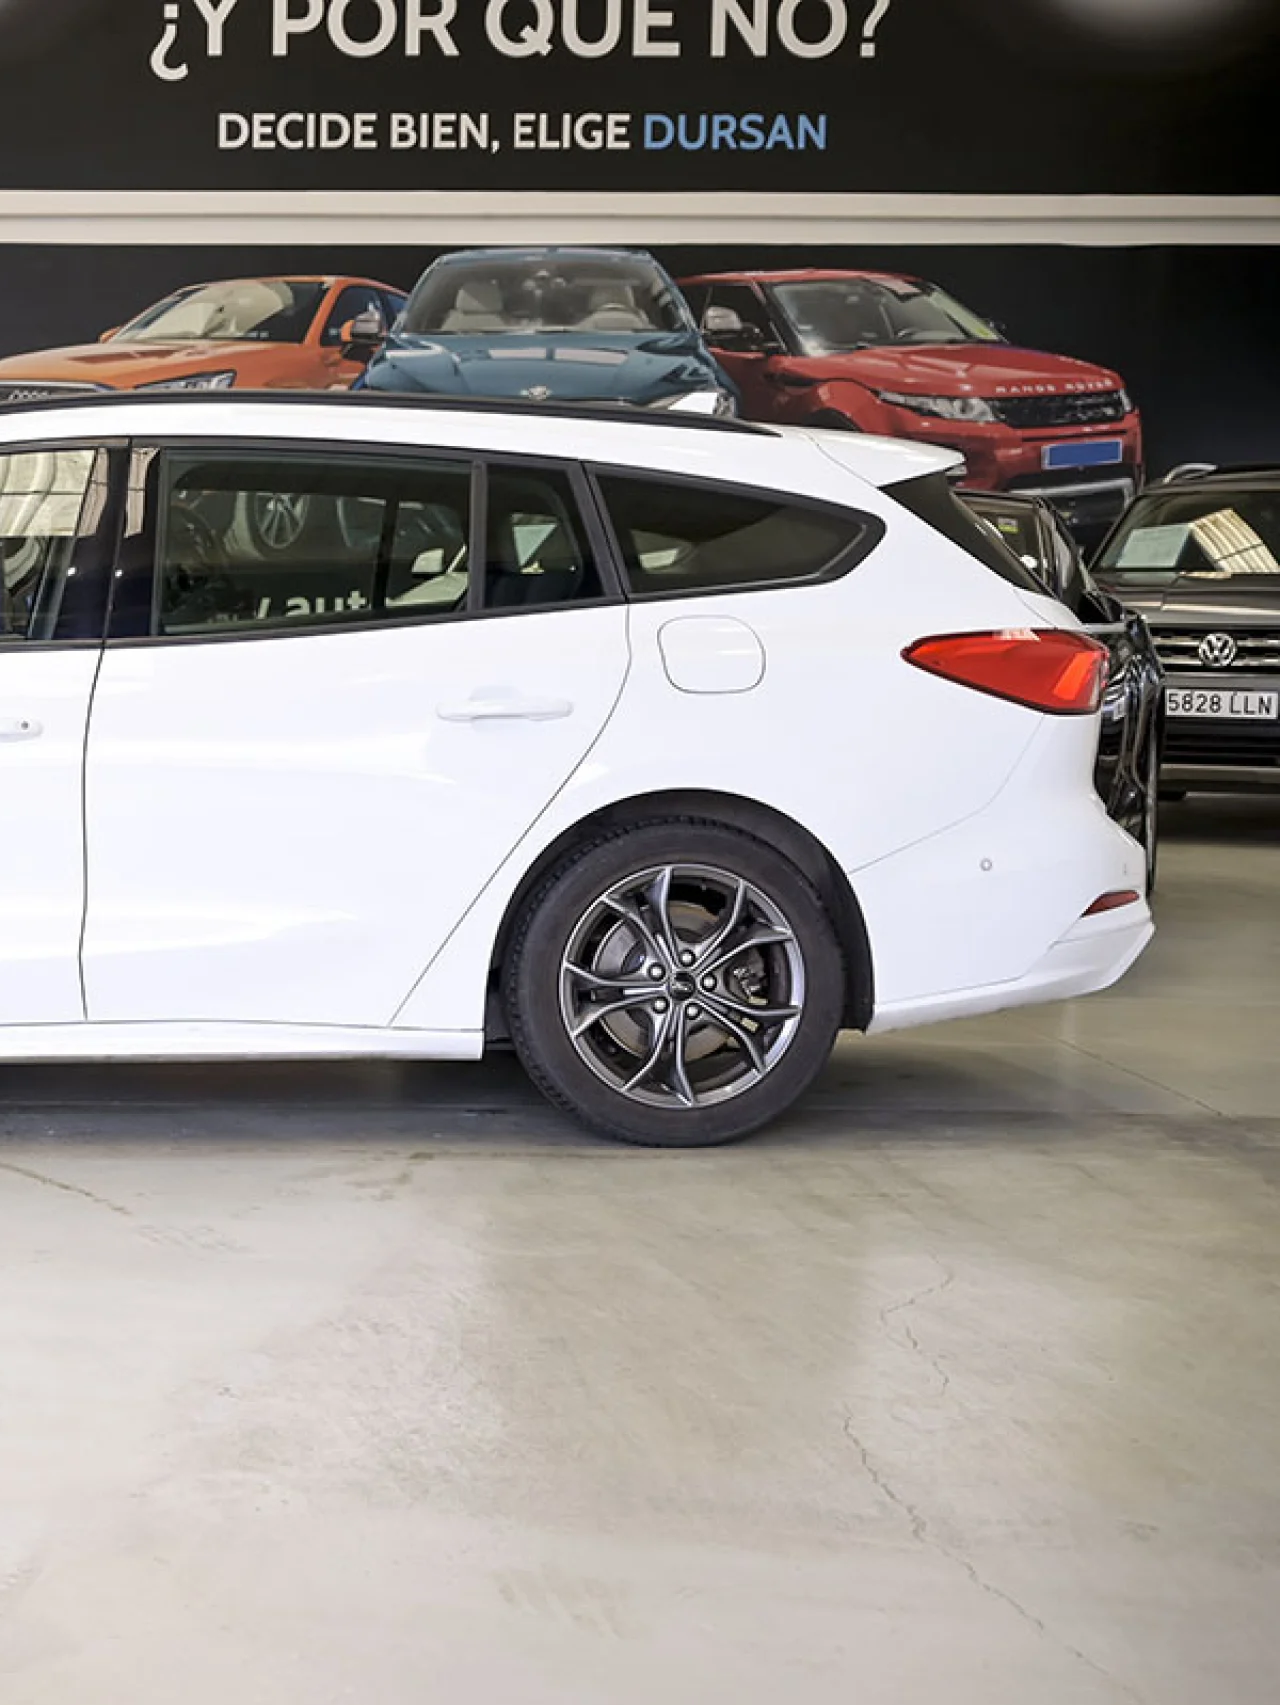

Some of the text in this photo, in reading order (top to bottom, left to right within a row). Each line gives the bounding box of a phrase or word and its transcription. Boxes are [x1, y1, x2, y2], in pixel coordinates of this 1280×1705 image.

[272, 0, 460, 58] POR
[710, 0, 891, 58] NO?
[218, 112, 827, 154] DECIDE BIEN, ELIGE DURSAN
[1168, 693, 1272, 715] 5828 LLN
